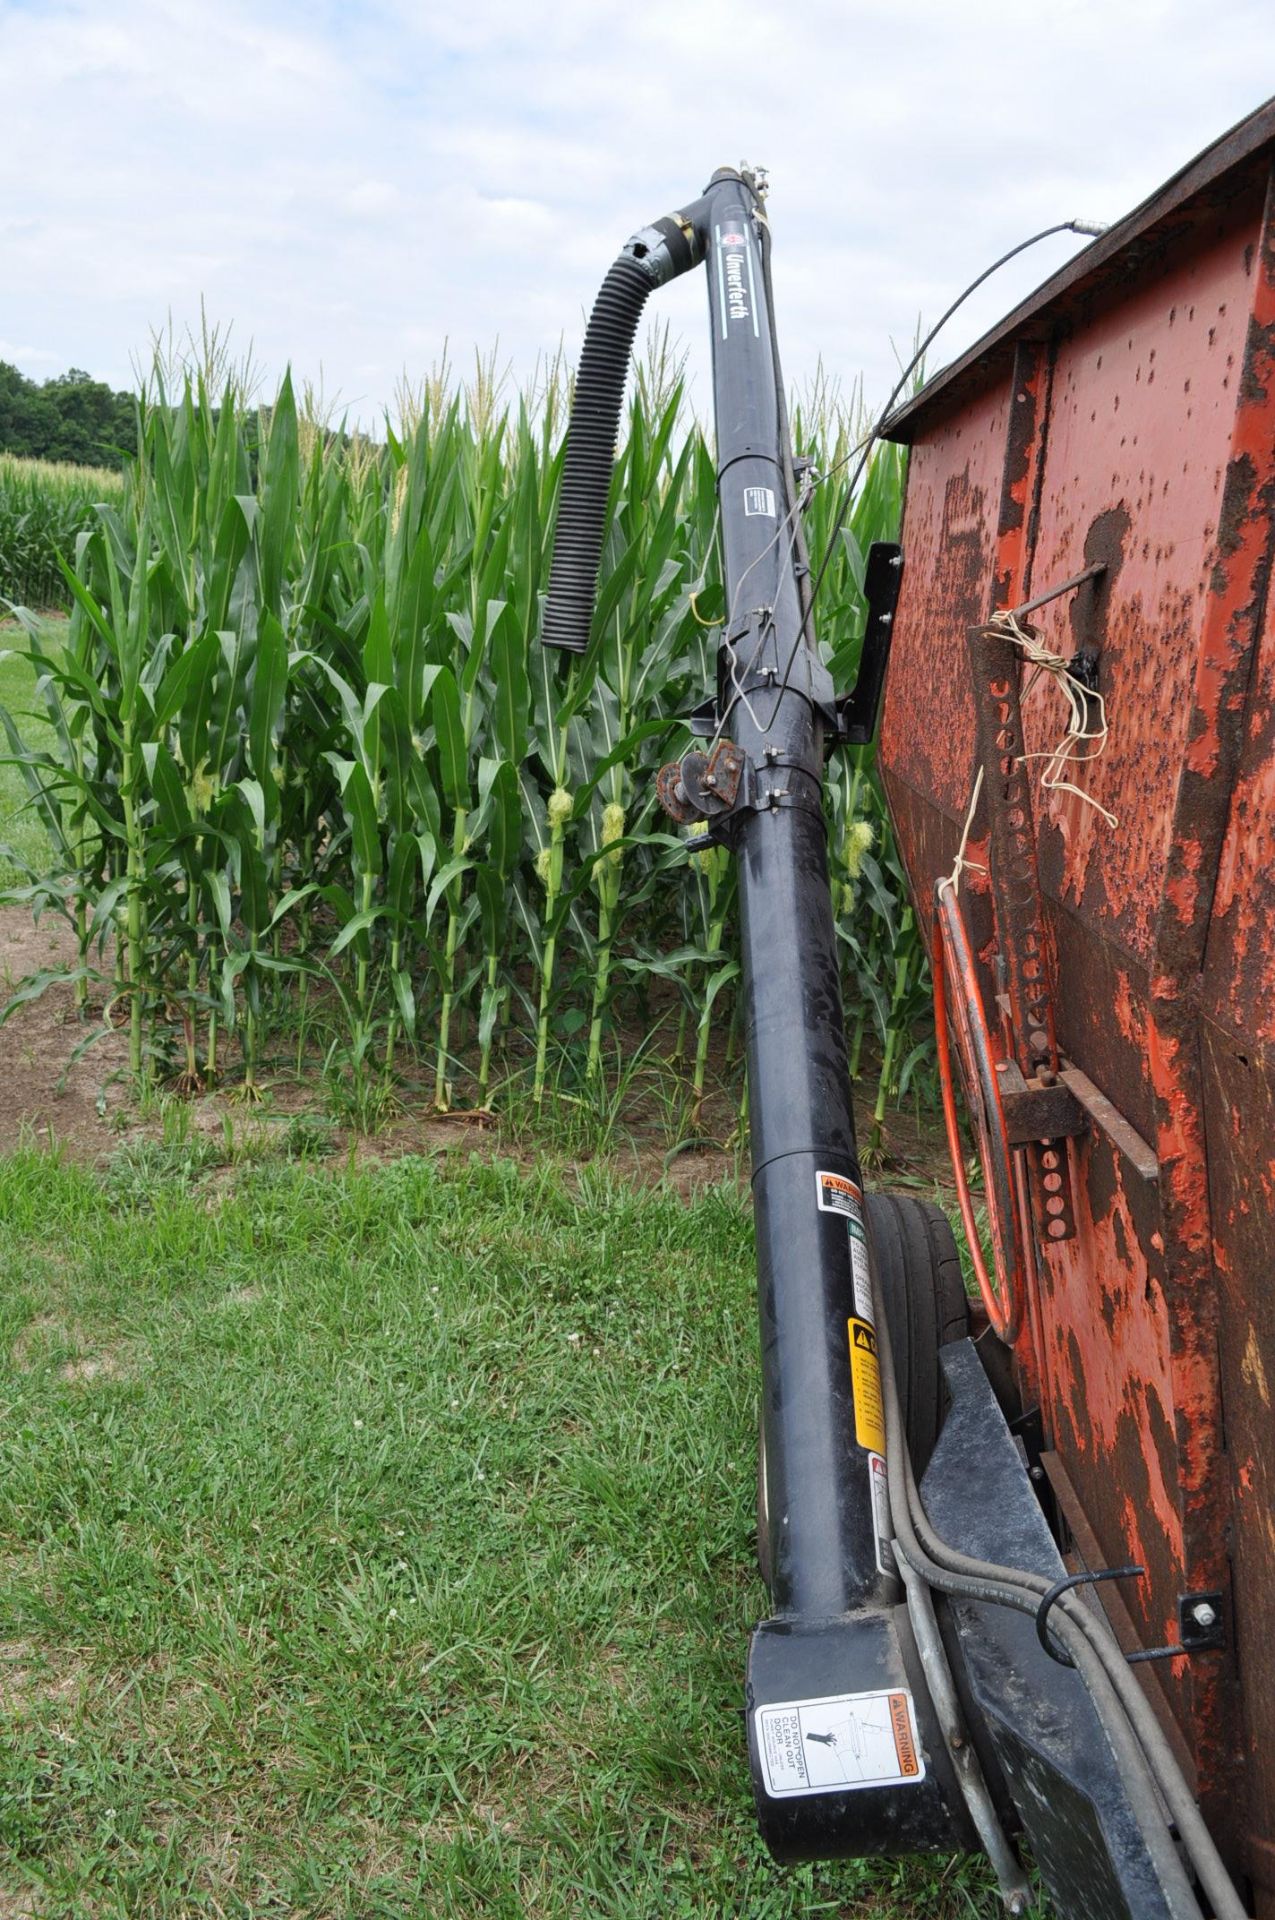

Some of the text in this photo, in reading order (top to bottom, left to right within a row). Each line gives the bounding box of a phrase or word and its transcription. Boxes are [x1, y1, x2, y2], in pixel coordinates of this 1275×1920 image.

[726, 253, 749, 319] Unverferth
[774, 1718, 783, 1744] DOOR
[782, 1717, 795, 1768] CLEAN OUT
[790, 1716, 805, 1778] DO NOT OPEN
[896, 1711, 914, 1773] WARNING
